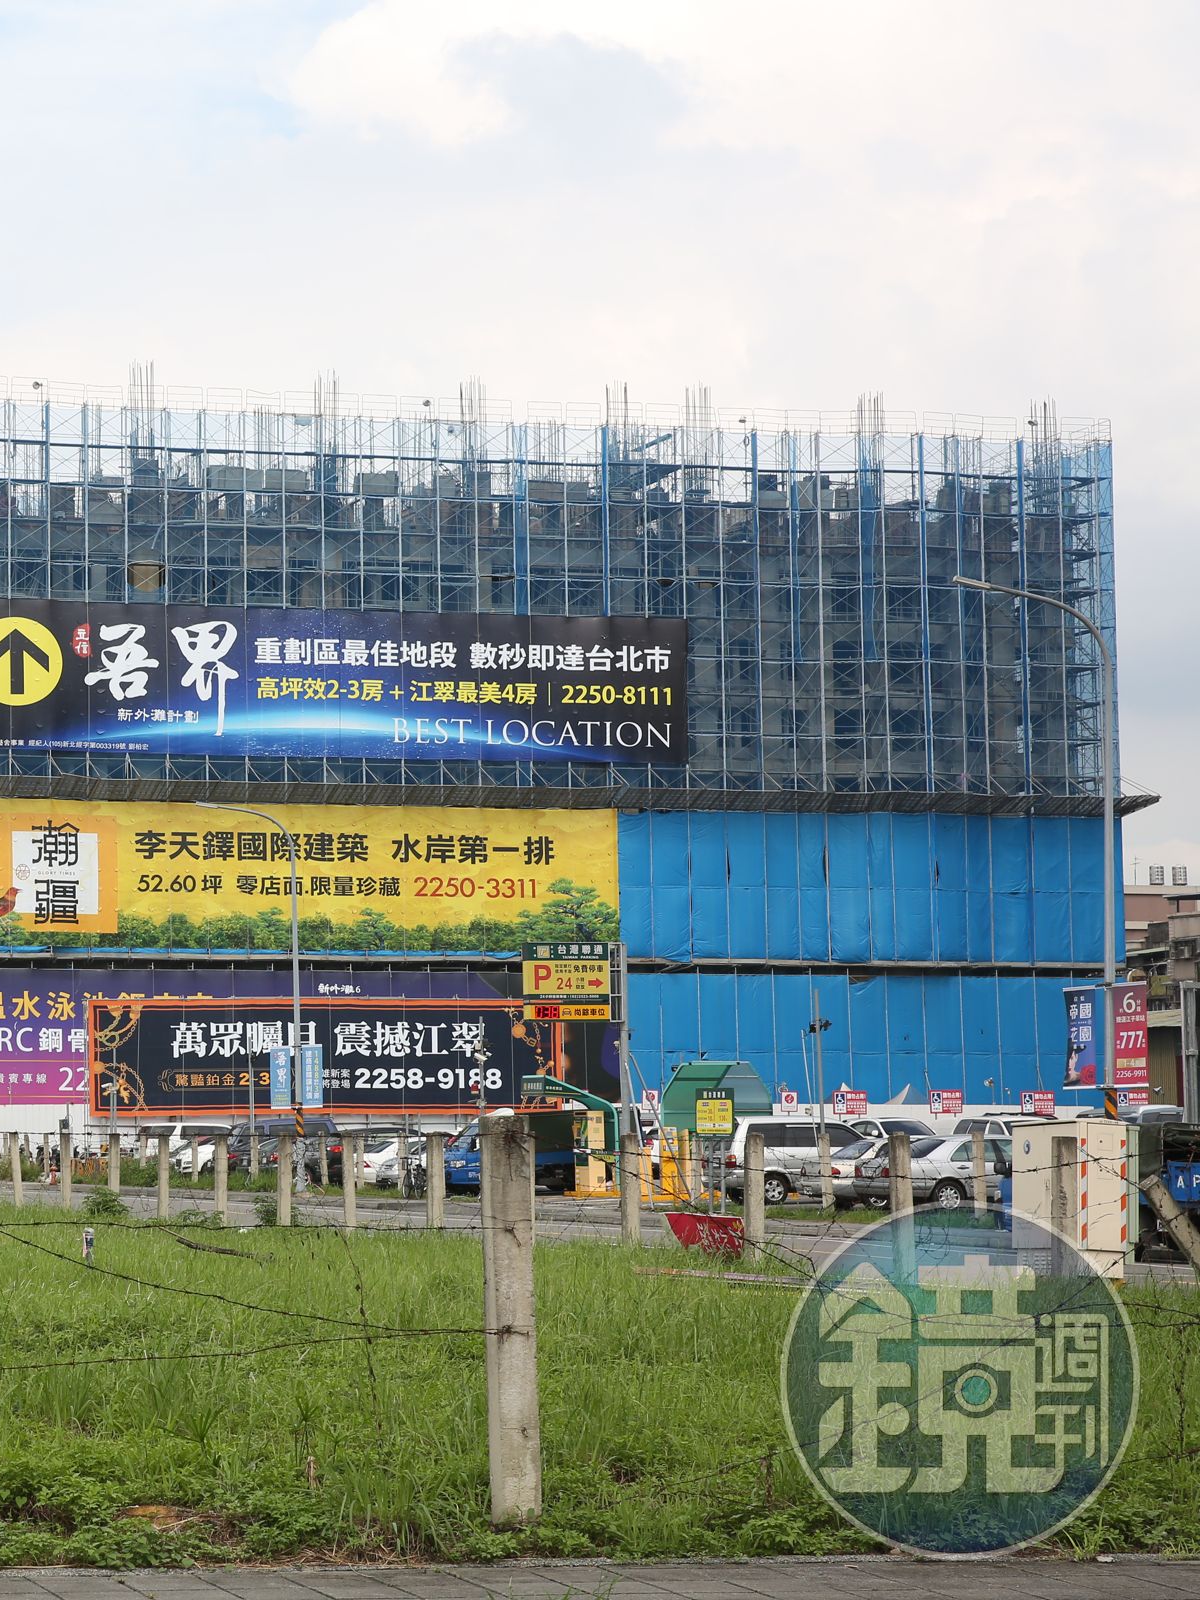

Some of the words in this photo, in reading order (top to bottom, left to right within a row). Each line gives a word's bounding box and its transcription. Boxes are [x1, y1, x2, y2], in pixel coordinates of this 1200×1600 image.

[253, 637, 457, 669] 重劃區最佳地段
[469, 642, 671, 673] 數秒即達台北市
[84, 621, 241, 737] 吾界
[256, 677, 384, 701] 高坪效2-3房
[410, 680, 537, 705] 江翠最美4房
[561, 684, 672, 706] 2250-8111
[117, 707, 199, 724] 新外灘計劃
[392, 717, 472, 745] BEST
[485, 719, 672, 749] LOCATION
[135, 829, 369, 863] 李天鐸國際建築
[391, 834, 555, 866] 水岸第一排
[413, 876, 537, 899] 2250-3311
[557, 944, 603, 955] 台灣聯通
[533, 964, 552, 990] P
[556, 977, 573, 990] 24
[1123, 992, 1137, 1013] 6
[333, 1021, 490, 1058] 震撼江翠
[1120, 1030, 1143, 1049] 777
[354, 1068, 503, 1090] 2258-9188
[1116, 1069, 1147, 1078] 2256-9911
